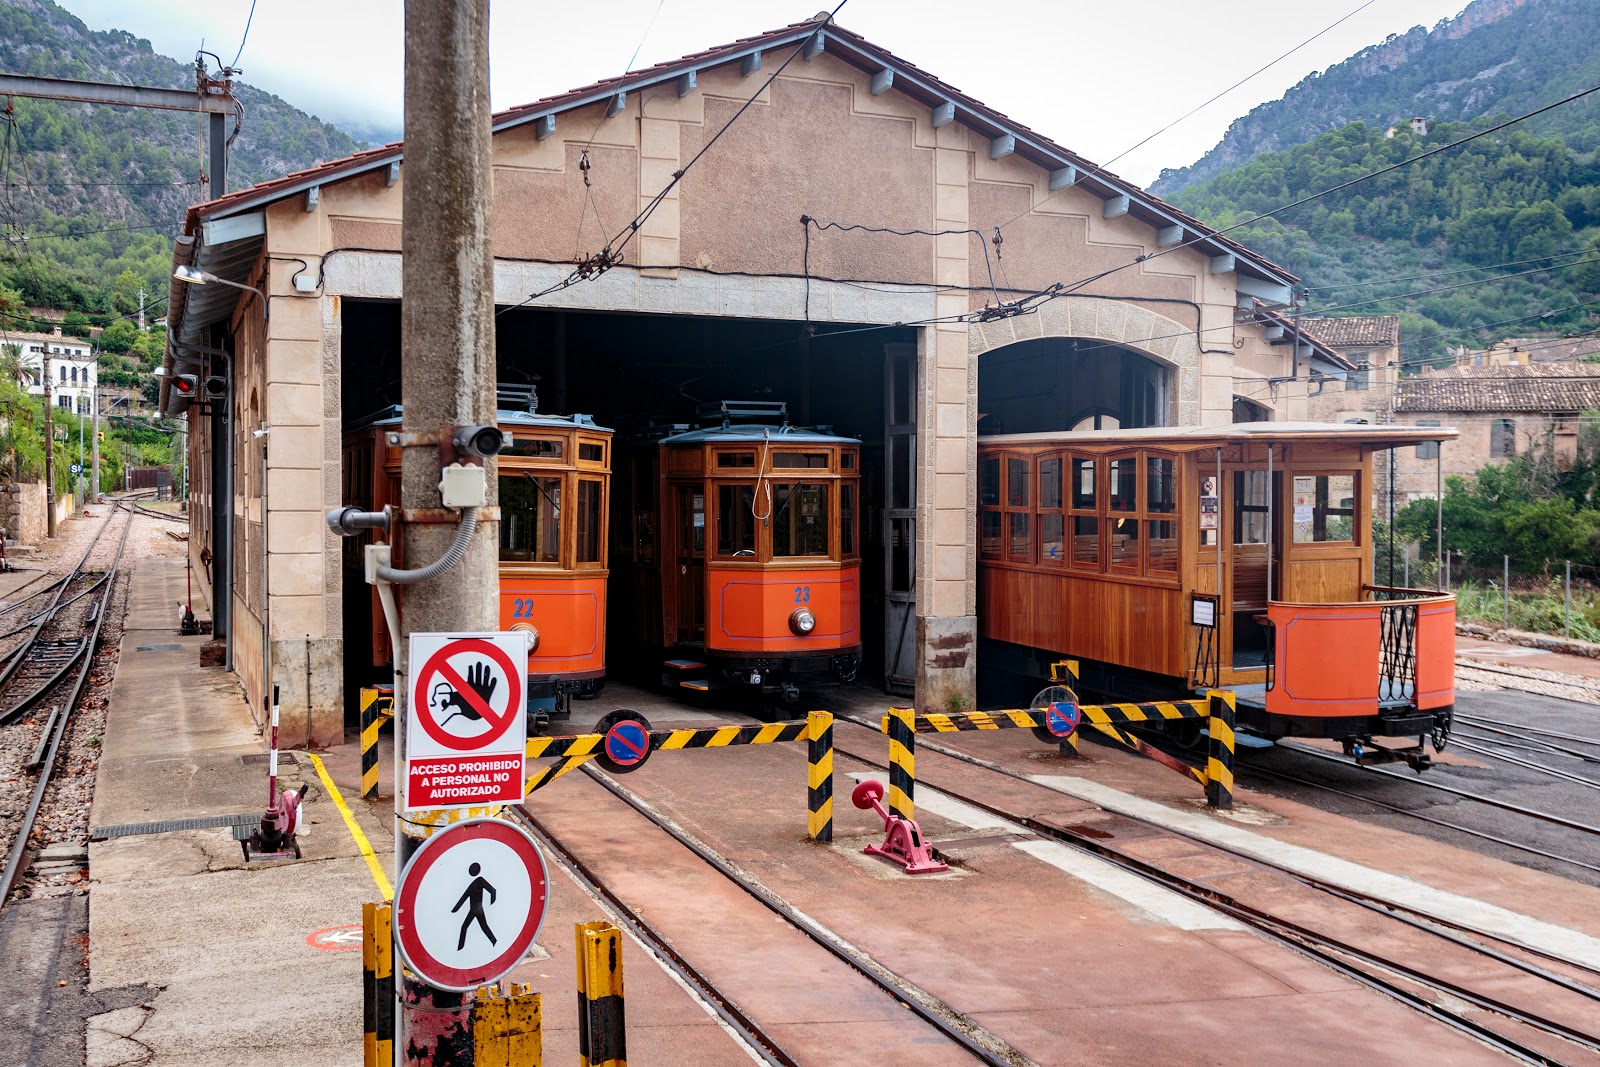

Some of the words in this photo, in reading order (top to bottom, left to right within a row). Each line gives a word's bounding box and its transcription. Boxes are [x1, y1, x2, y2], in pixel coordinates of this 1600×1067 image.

[794, 587, 810, 603] 23
[513, 599, 534, 618] 22
[410, 763, 457, 775] ACCESO
[459, 760, 521, 772] PROHIBIDO
[421, 778, 430, 787] A
[432, 774, 491, 786] PERSONAL
[493, 772, 510, 782] NO
[430, 785, 501, 798] AUTORIZADO
